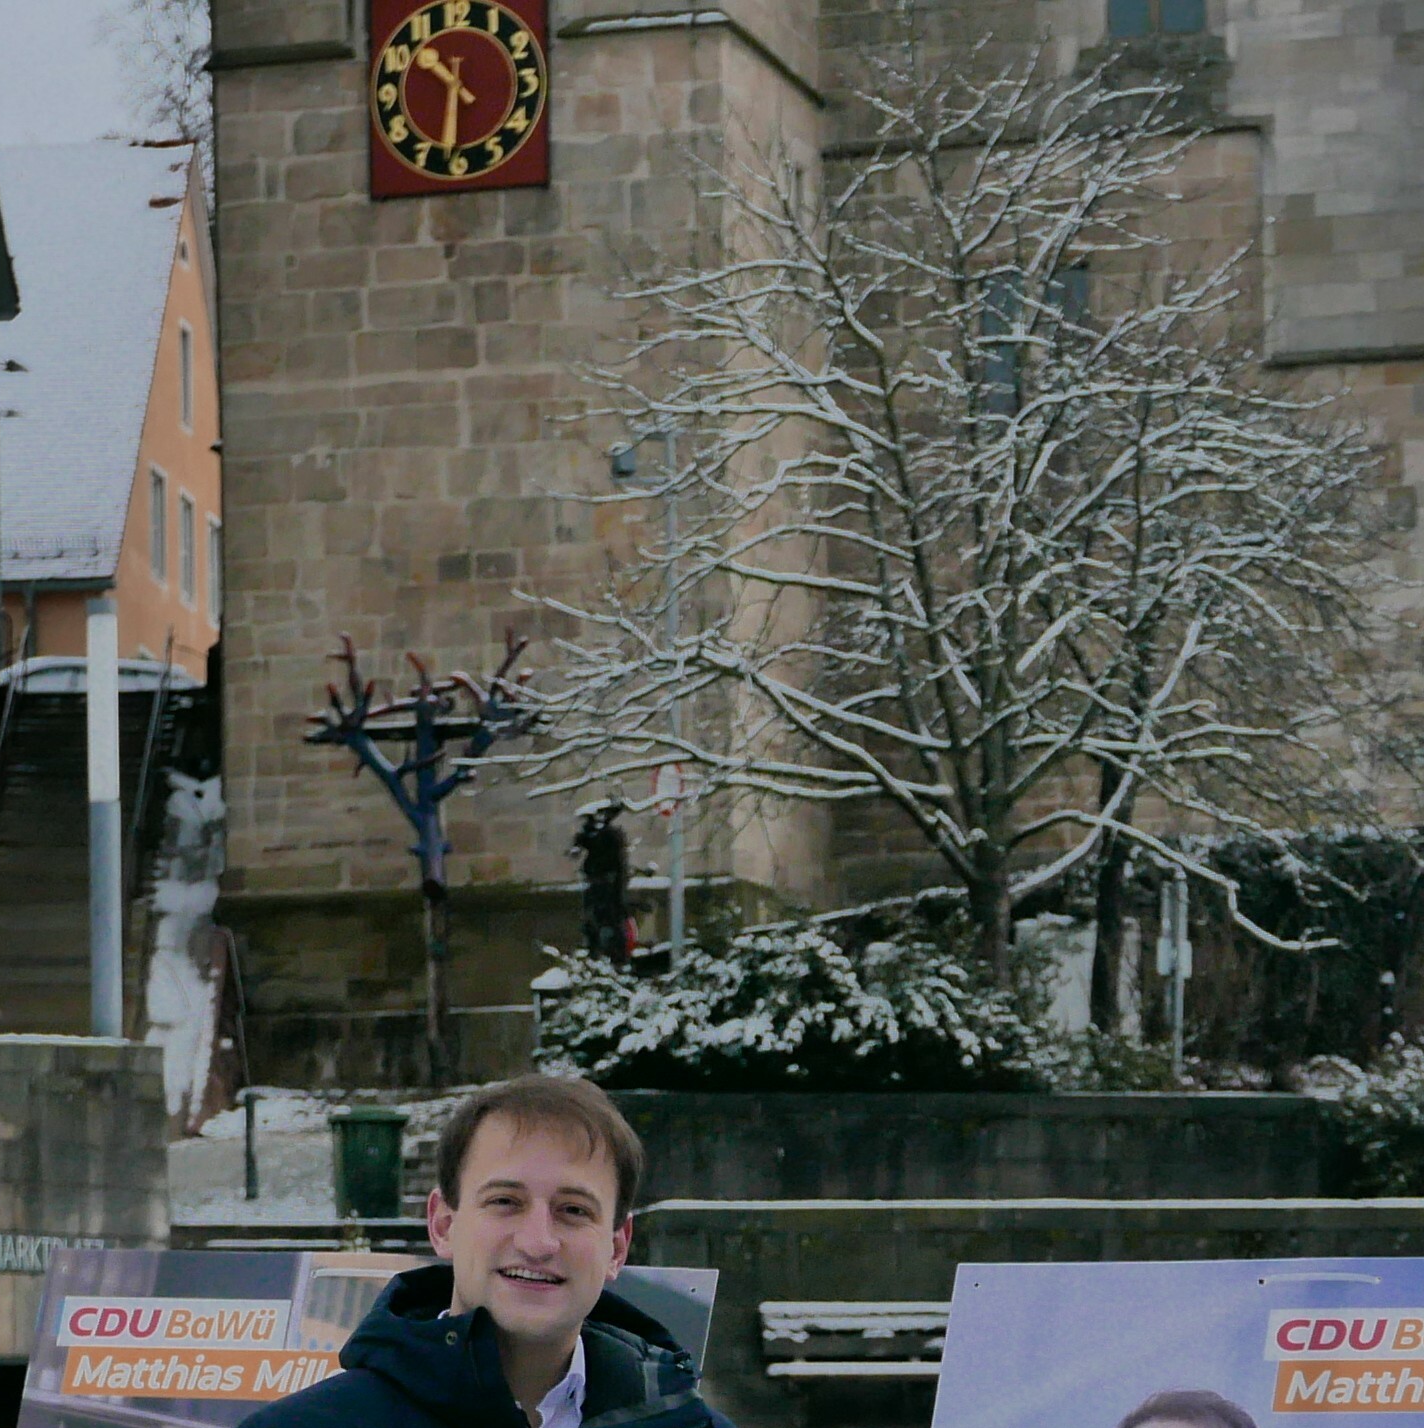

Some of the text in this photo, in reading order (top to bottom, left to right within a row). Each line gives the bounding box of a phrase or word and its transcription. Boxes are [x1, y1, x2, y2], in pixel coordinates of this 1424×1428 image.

[411, 13, 431, 40] 11
[444, 1, 470, 27] 12
[487, 7, 499, 34] 1
[385, 44, 410, 72] 10
[510, 31, 529, 59] 2
[518, 67, 539, 97] 3
[379, 83, 398, 111] 9
[389, 114, 409, 143] 8
[505, 105, 530, 133] 4
[413, 142, 432, 167] 7
[449, 148, 468, 175] 6
[484, 137, 504, 165] 5
[68, 1307, 275, 1341] CDU BaWü
[1276, 1318, 1387, 1352] CDU
[72, 1354, 347, 1393] Matthias Mill
